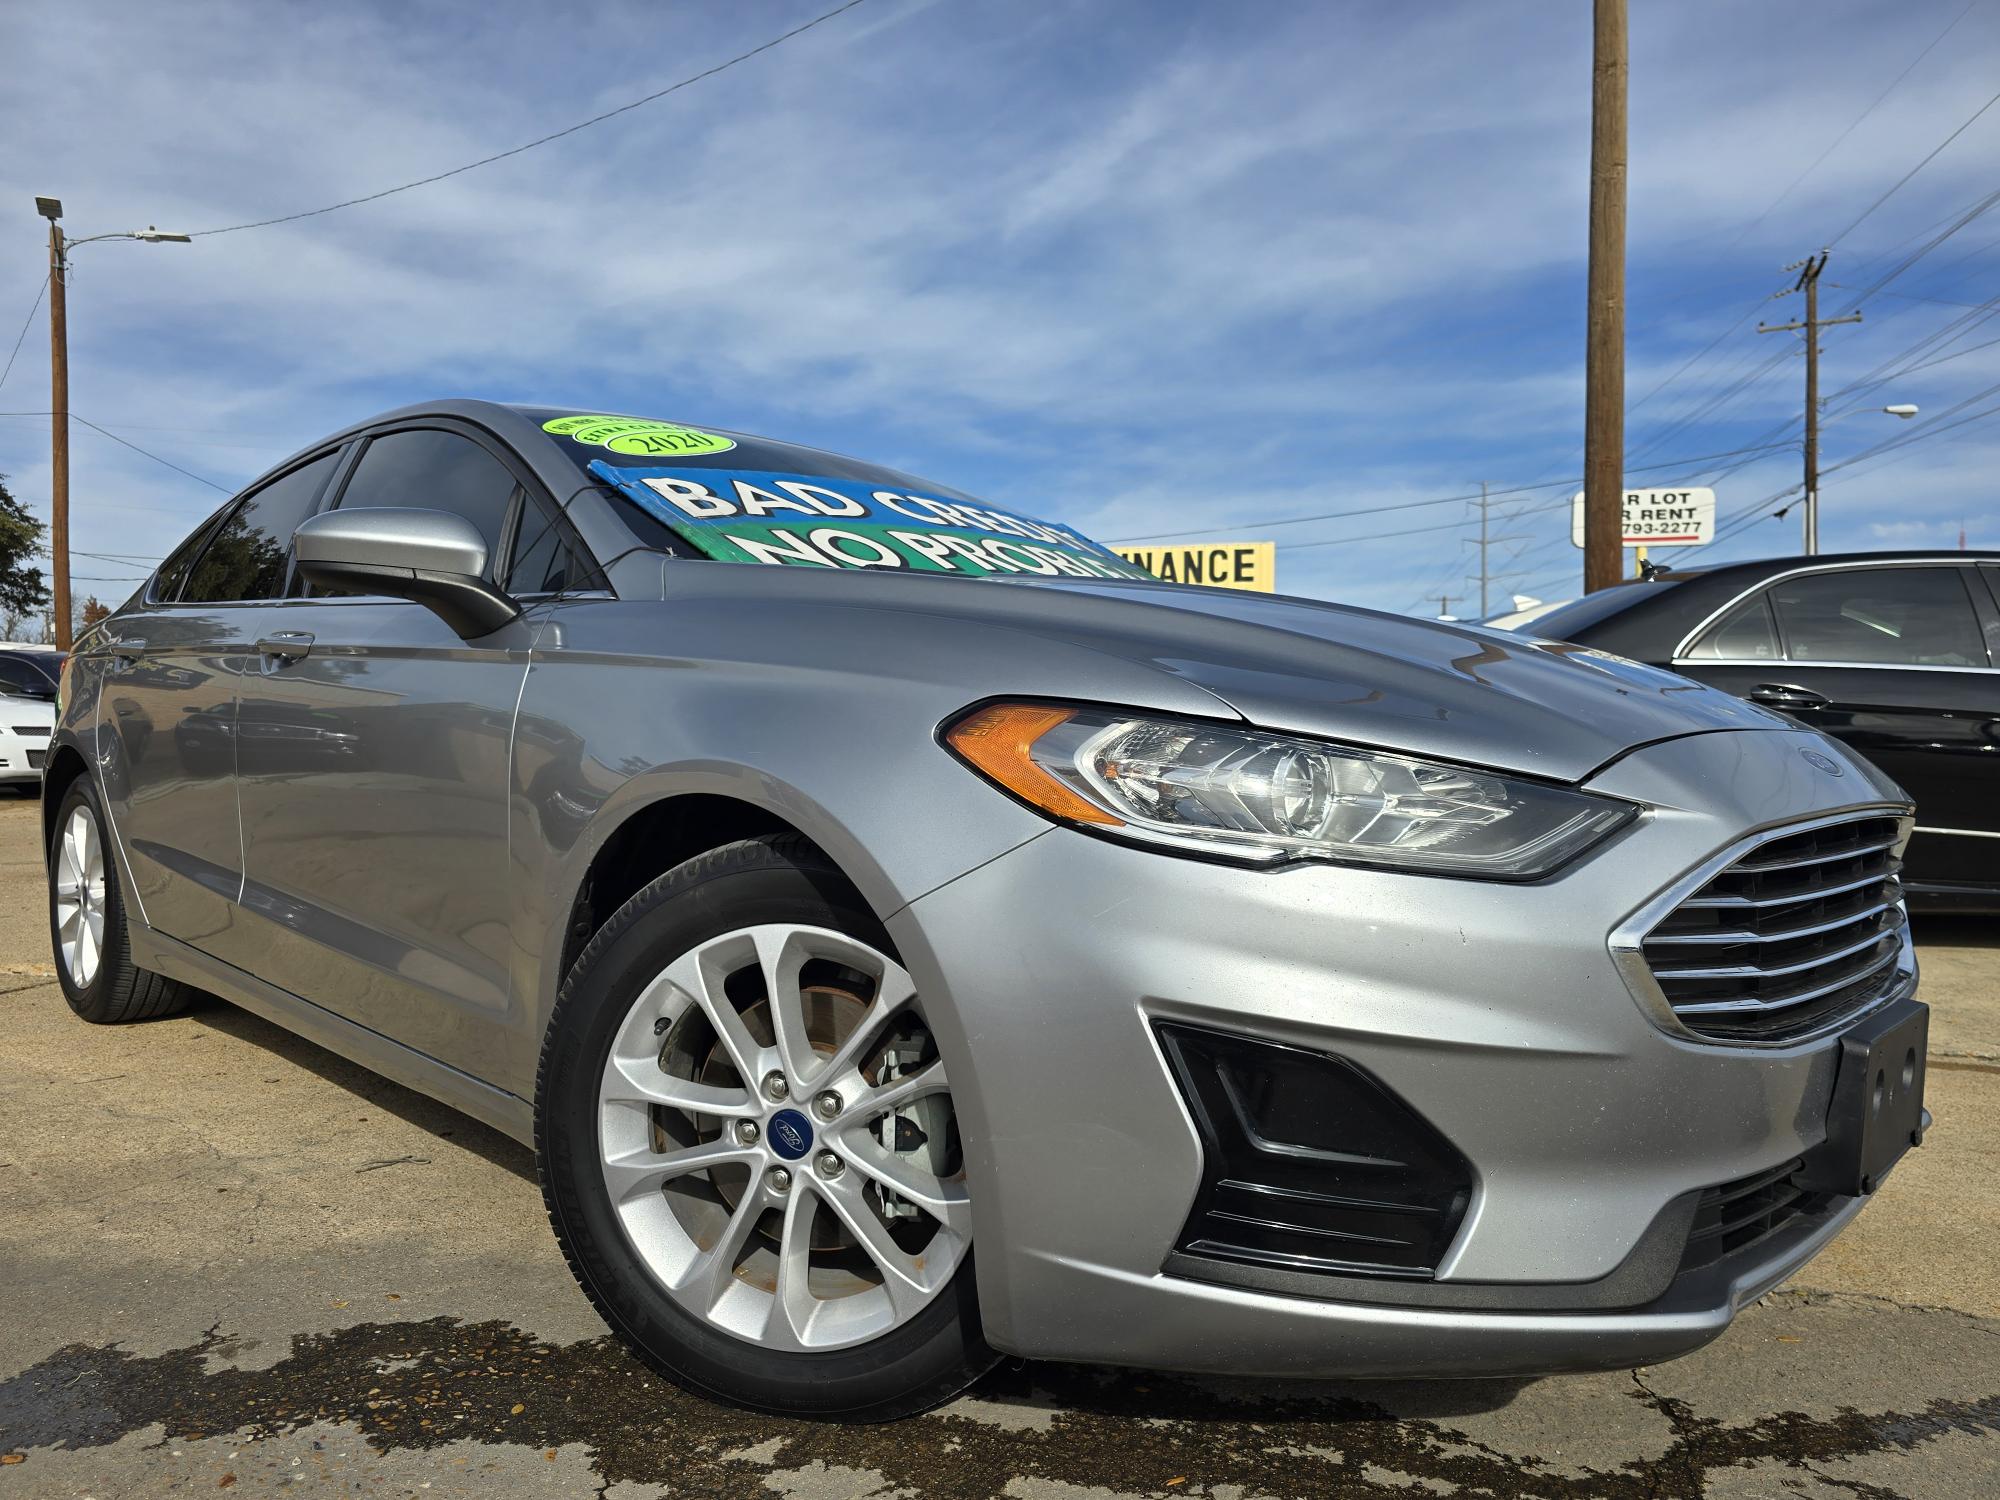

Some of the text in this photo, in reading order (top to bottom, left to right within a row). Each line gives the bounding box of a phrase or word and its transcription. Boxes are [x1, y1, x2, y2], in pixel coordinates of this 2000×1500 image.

[583, 425, 627, 442] EXTRA
[629, 434, 714, 452] 2020
[641, 477, 866, 518] BAD
[1650, 493, 1691, 505] LOT
[1641, 508, 1697, 520] RENT
[726, 529, 902, 570] NO
